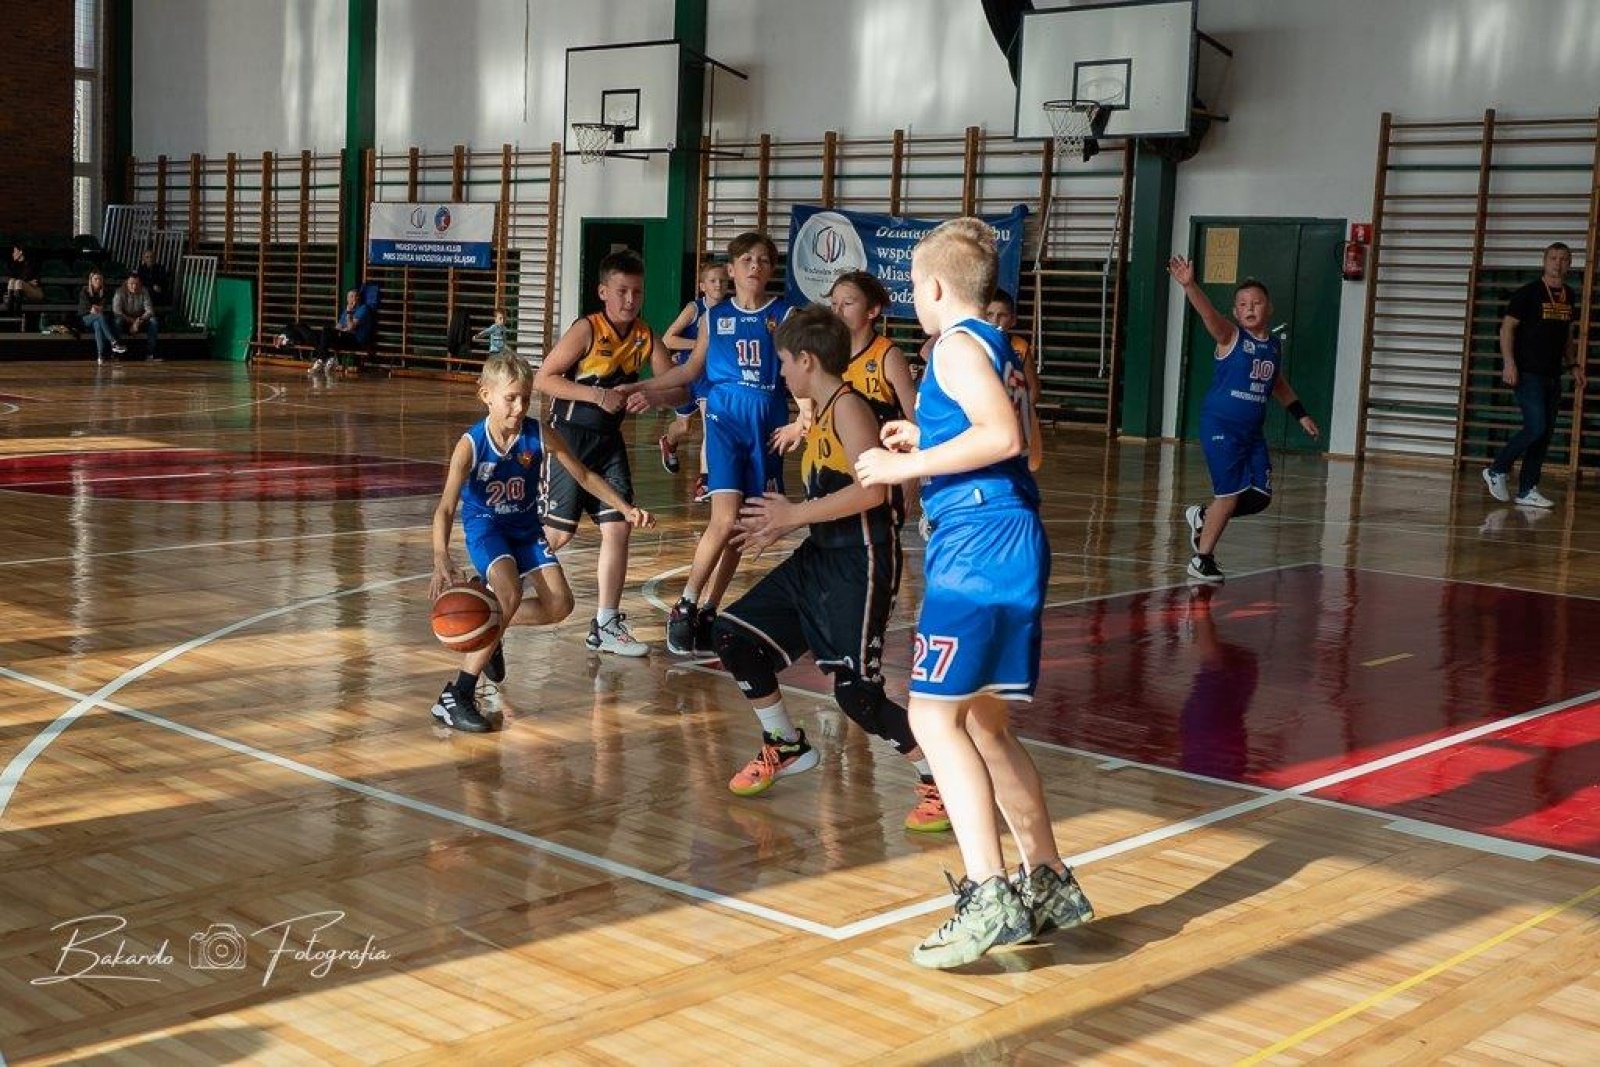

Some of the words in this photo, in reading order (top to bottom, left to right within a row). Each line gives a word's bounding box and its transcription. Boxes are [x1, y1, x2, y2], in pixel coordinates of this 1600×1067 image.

[877, 245, 913, 262] wspó
[877, 264, 911, 281] Mias
[883, 287, 914, 304] odz
[736, 339, 761, 367] 11
[1250, 358, 1274, 381] 10
[865, 377, 881, 393] 12
[485, 476, 526, 507] 20
[911, 632, 959, 683] 27
